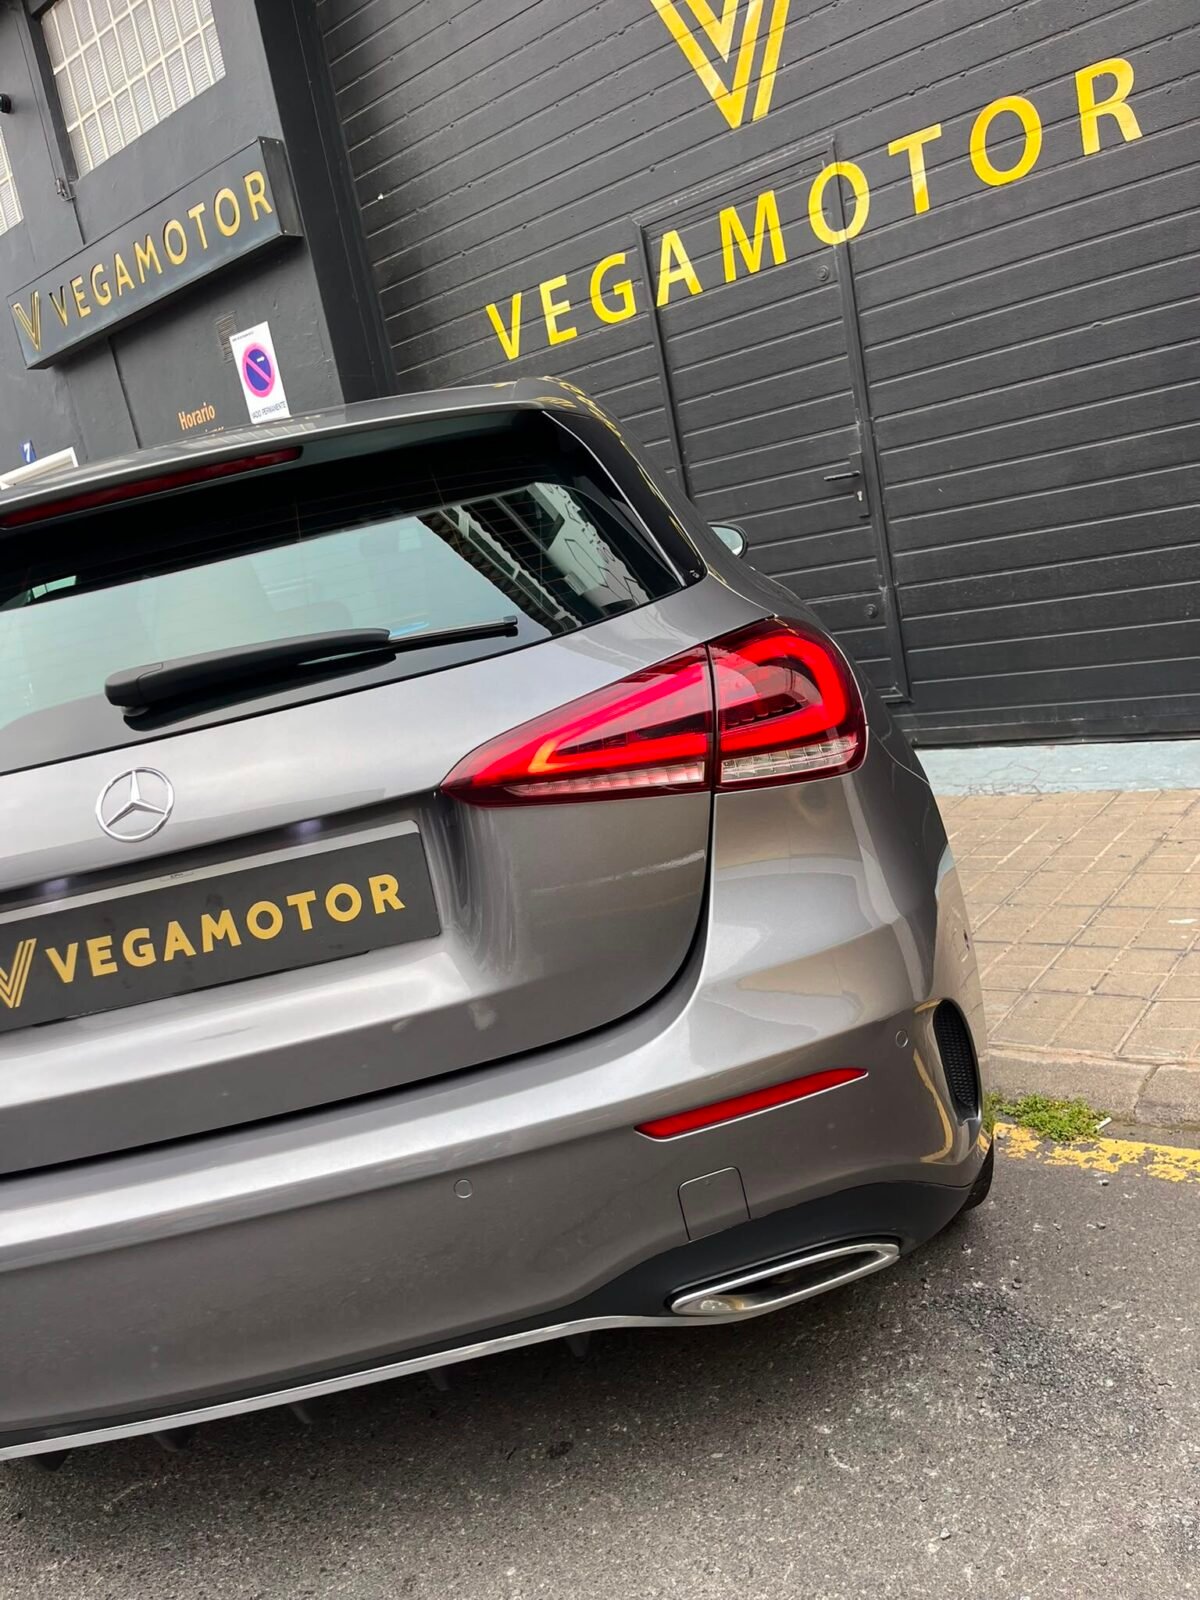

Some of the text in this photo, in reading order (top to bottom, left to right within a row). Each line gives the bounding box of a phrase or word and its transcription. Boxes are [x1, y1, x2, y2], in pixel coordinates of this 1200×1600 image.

[49, 170, 273, 327] VEGAMOTOR
[485, 57, 1143, 361] VEGAMOTOR
[23, 442, 31, 463] 7
[178, 401, 216, 431] Horario
[46, 873, 406, 984] VEGAMOTOR
